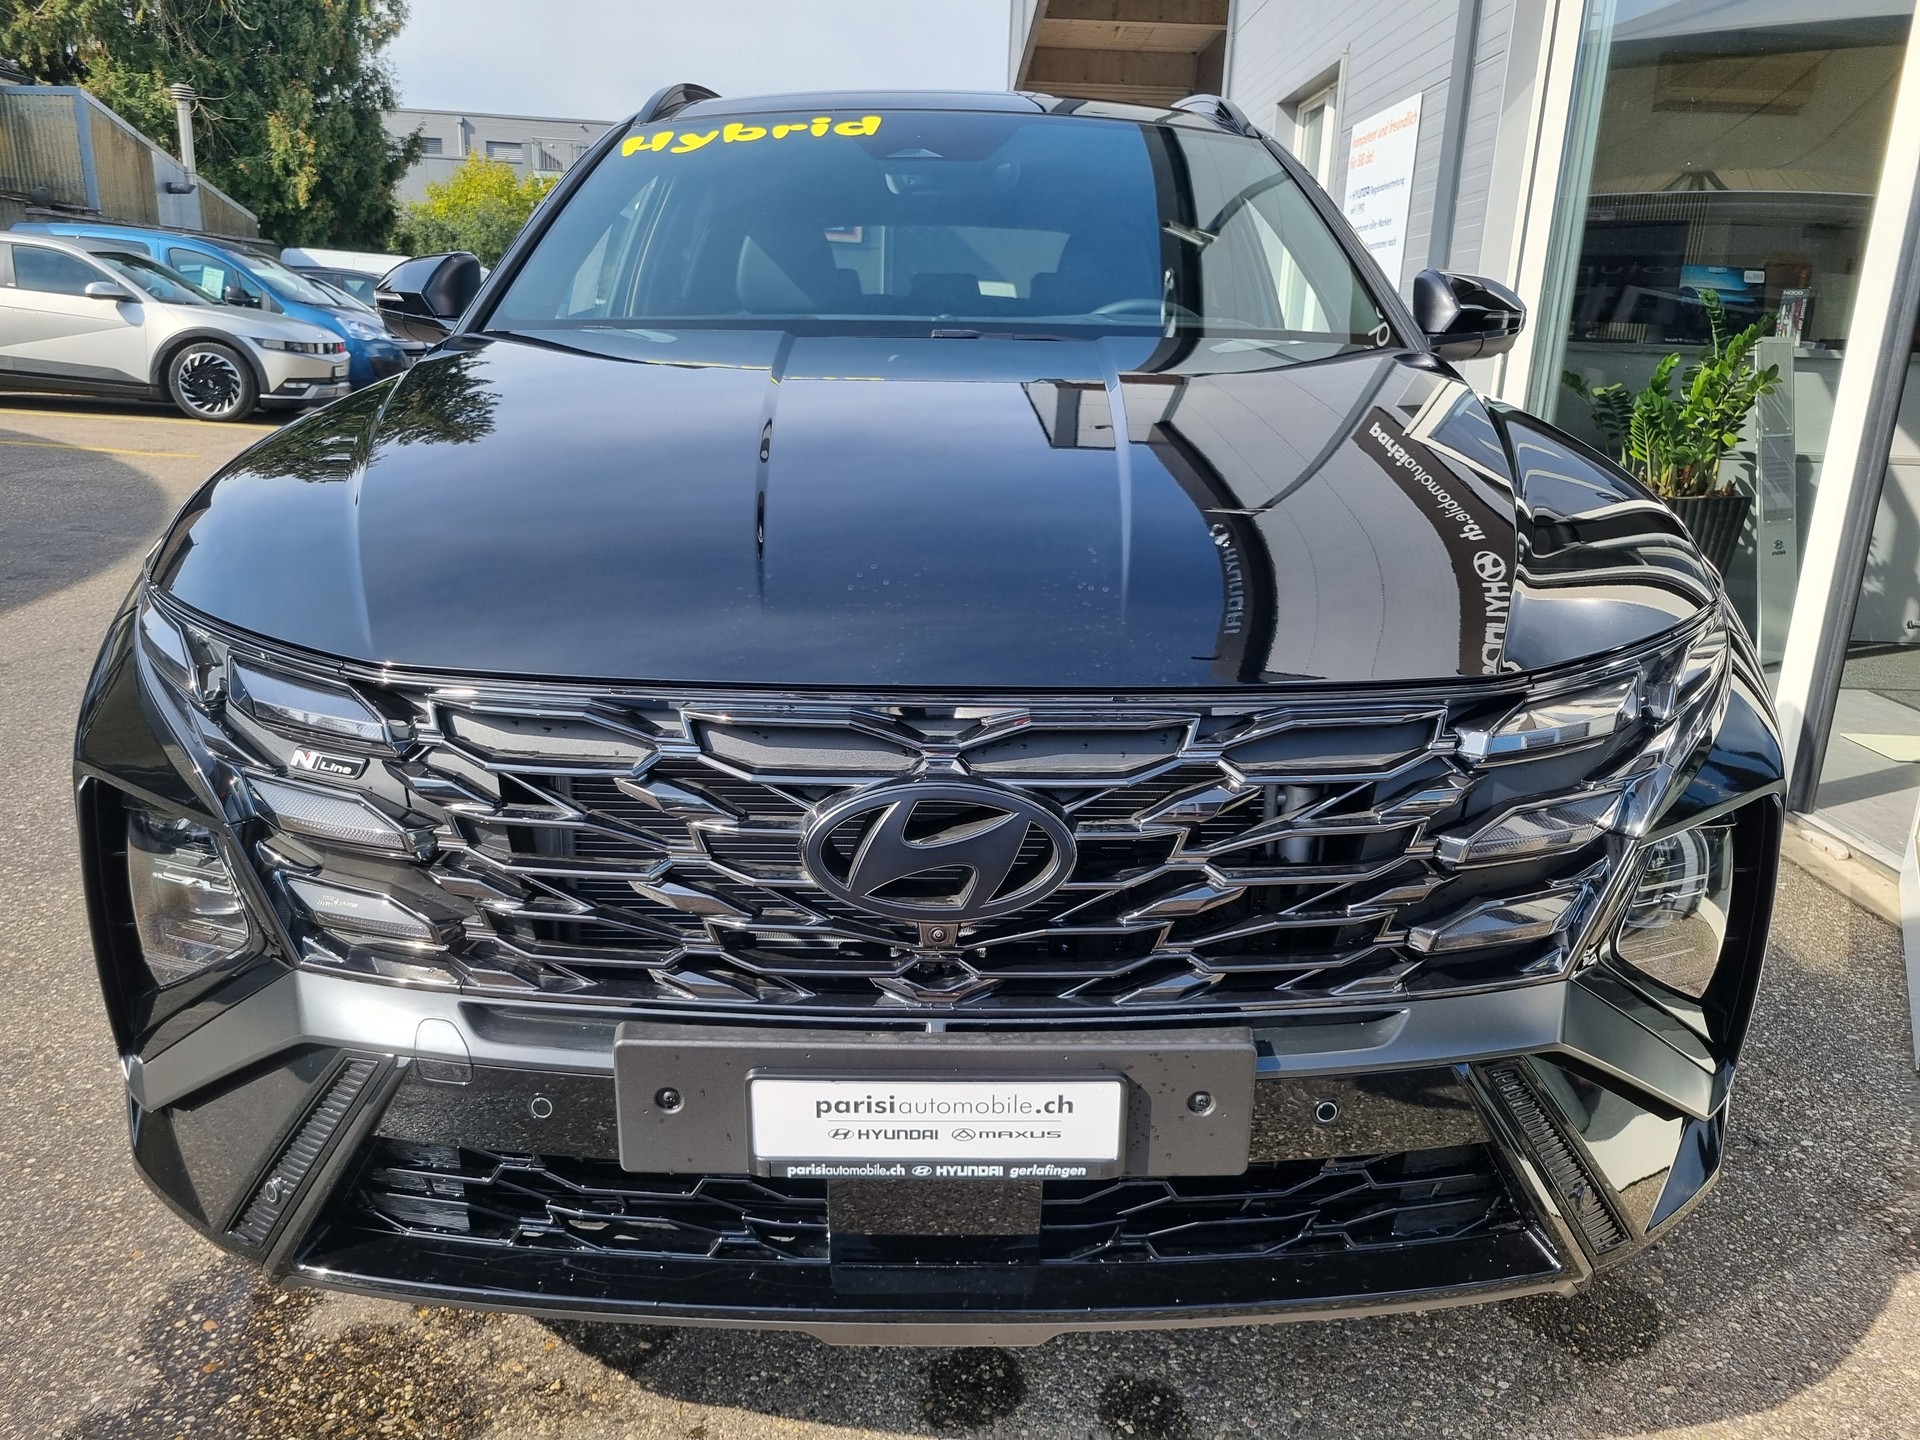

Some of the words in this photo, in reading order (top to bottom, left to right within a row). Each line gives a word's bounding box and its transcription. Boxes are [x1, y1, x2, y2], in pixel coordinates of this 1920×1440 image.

[1389, 109, 1418, 134] freundlich
[621, 115, 883, 157] Hybrid
[290, 749, 320, 770] N
[320, 761, 352, 775] Line
[815, 1094, 1074, 1119] parisiautomobile.ch
[858, 1129, 939, 1141] HYUNDAI
[979, 1129, 1062, 1139] MAXUS
[787, 1163, 906, 1178] parisiautomobile.ch
[936, 1165, 1004, 1178] HYUNDAI
[1009, 1163, 1087, 1178] gerlafingen
